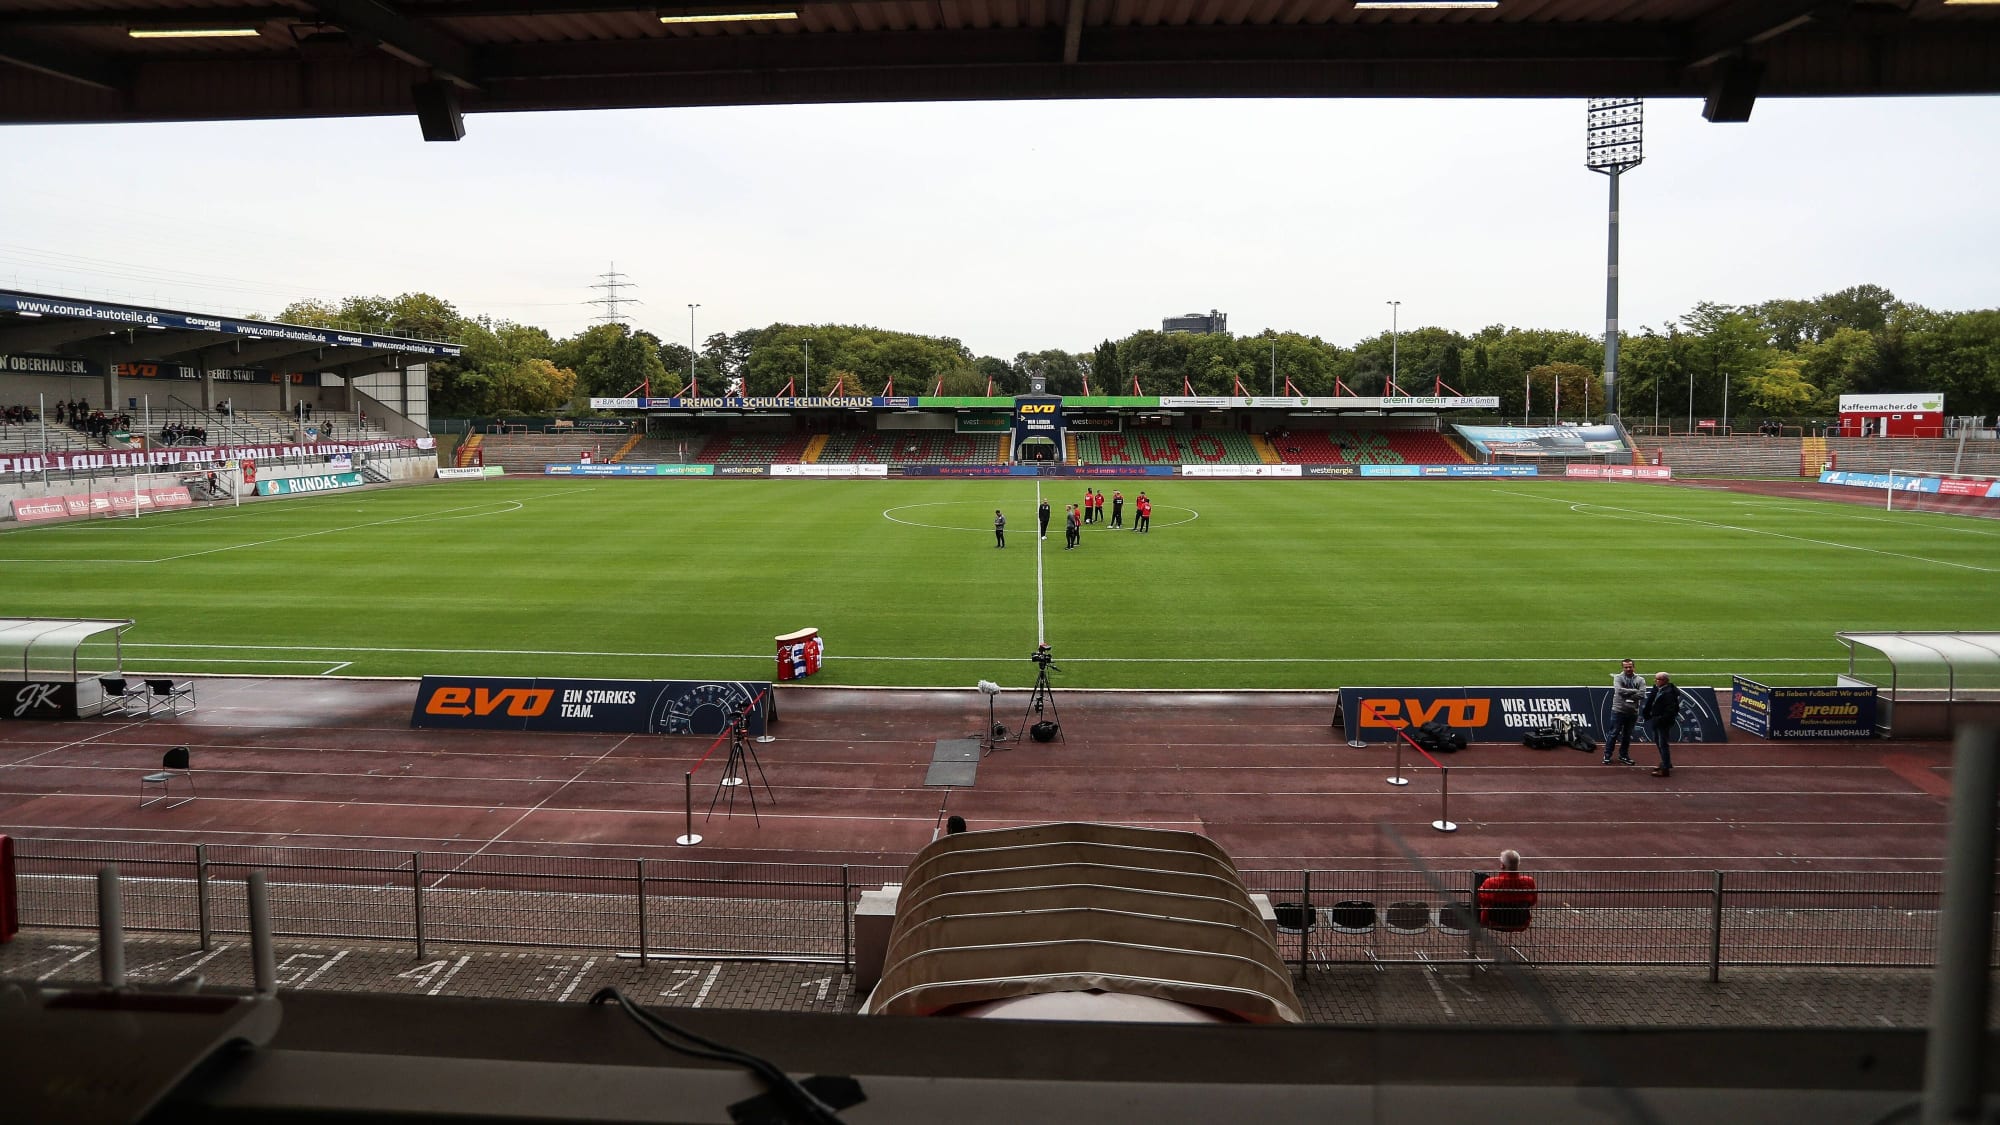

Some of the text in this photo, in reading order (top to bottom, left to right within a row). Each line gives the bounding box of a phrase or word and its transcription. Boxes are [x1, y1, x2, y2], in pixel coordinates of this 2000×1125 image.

[16, 301, 159, 325] www.conrad-autoteile.de
[185, 316, 221, 328] Conrad
[237, 325, 326, 343] www.conrad-autoteile.de
[337, 334, 362, 344] Conrad
[372, 341, 435, 354] www.conrad-autoteile.de
[11, 357, 88, 374] OBERHAUSEN.
[117, 363, 158, 377] evo
[179, 366, 196, 378] TEIL
[233, 369, 256, 381] STADT
[680, 397, 873, 407] PREMIO H. SCHULTE-KELLINGHAUS
[1020, 404, 1056, 414] evo
[1840, 403, 1918, 411] Kaffeemacher.de
[963, 417, 1005, 426] westenergie
[1072, 417, 1114, 426] westenergie
[1099, 433, 1227, 463] RWO
[665, 466, 706, 474] westenergie
[721, 466, 764, 474] westenergie
[1310, 466, 1354, 475] westenergie
[289, 475, 339, 493] RUNDAS
[14, 683, 62, 717] JK
[425, 686, 555, 718] evo
[562, 689, 637, 705] EIN STARKES
[1739, 695, 1766, 710] premio
[560, 704, 594, 719] TEAM.
[1500, 698, 1572, 712] WIR LIEBEN
[1802, 702, 1859, 718] premio
[1360, 697, 1491, 729] evo
[1773, 729, 1871, 737] H. SCHULTE-KELLINGHAUS
[399, 959, 449, 989] 4
